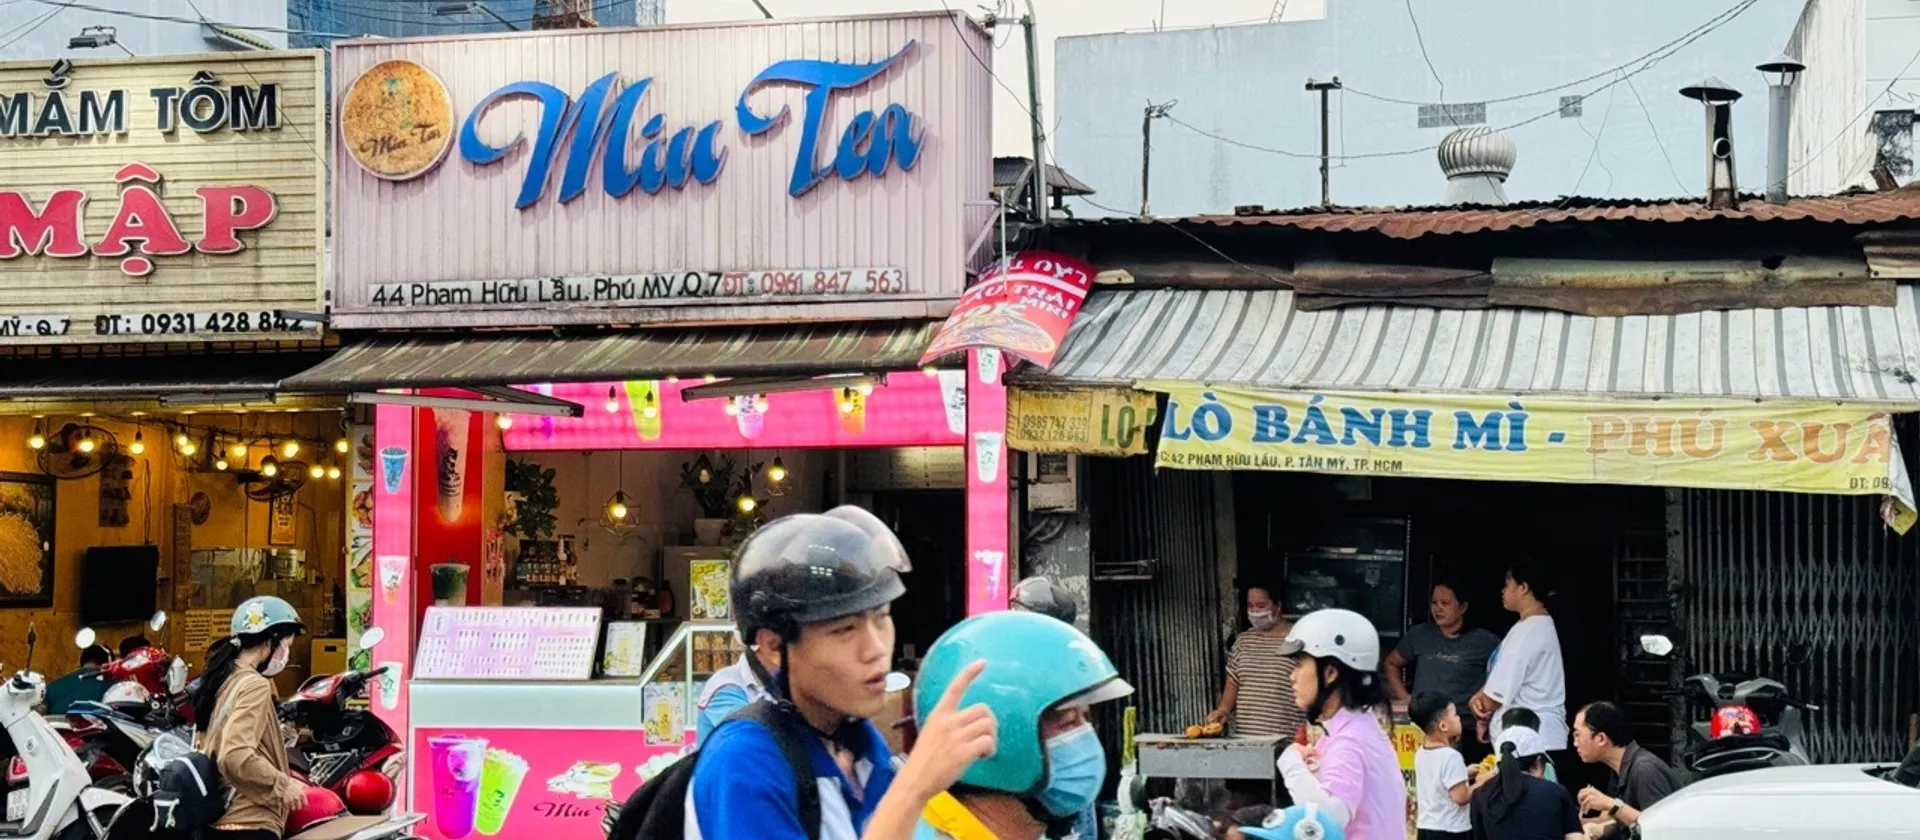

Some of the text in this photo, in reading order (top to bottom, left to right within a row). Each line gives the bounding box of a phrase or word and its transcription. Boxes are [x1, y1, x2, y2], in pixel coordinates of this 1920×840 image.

[150, 71, 283, 132] TÔM
[735, 39, 926, 198] Tea
[0, 161, 278, 276] MẬP
[372, 284, 404, 307] 44
[761, 271, 803, 295] 0961
[813, 270, 852, 295] 847
[865, 269, 903, 294] 563
[94, 314, 131, 335] ĐT:
[141, 313, 195, 334] 0931
[205, 312, 250, 332] 428
[1162, 391, 1233, 442] LÒ
[1250, 395, 1434, 449] BÁNH
[1452, 400, 1530, 452] MÌ
[1584, 406, 1727, 458] PHÚ
[1373, 459, 1403, 472] HCM
